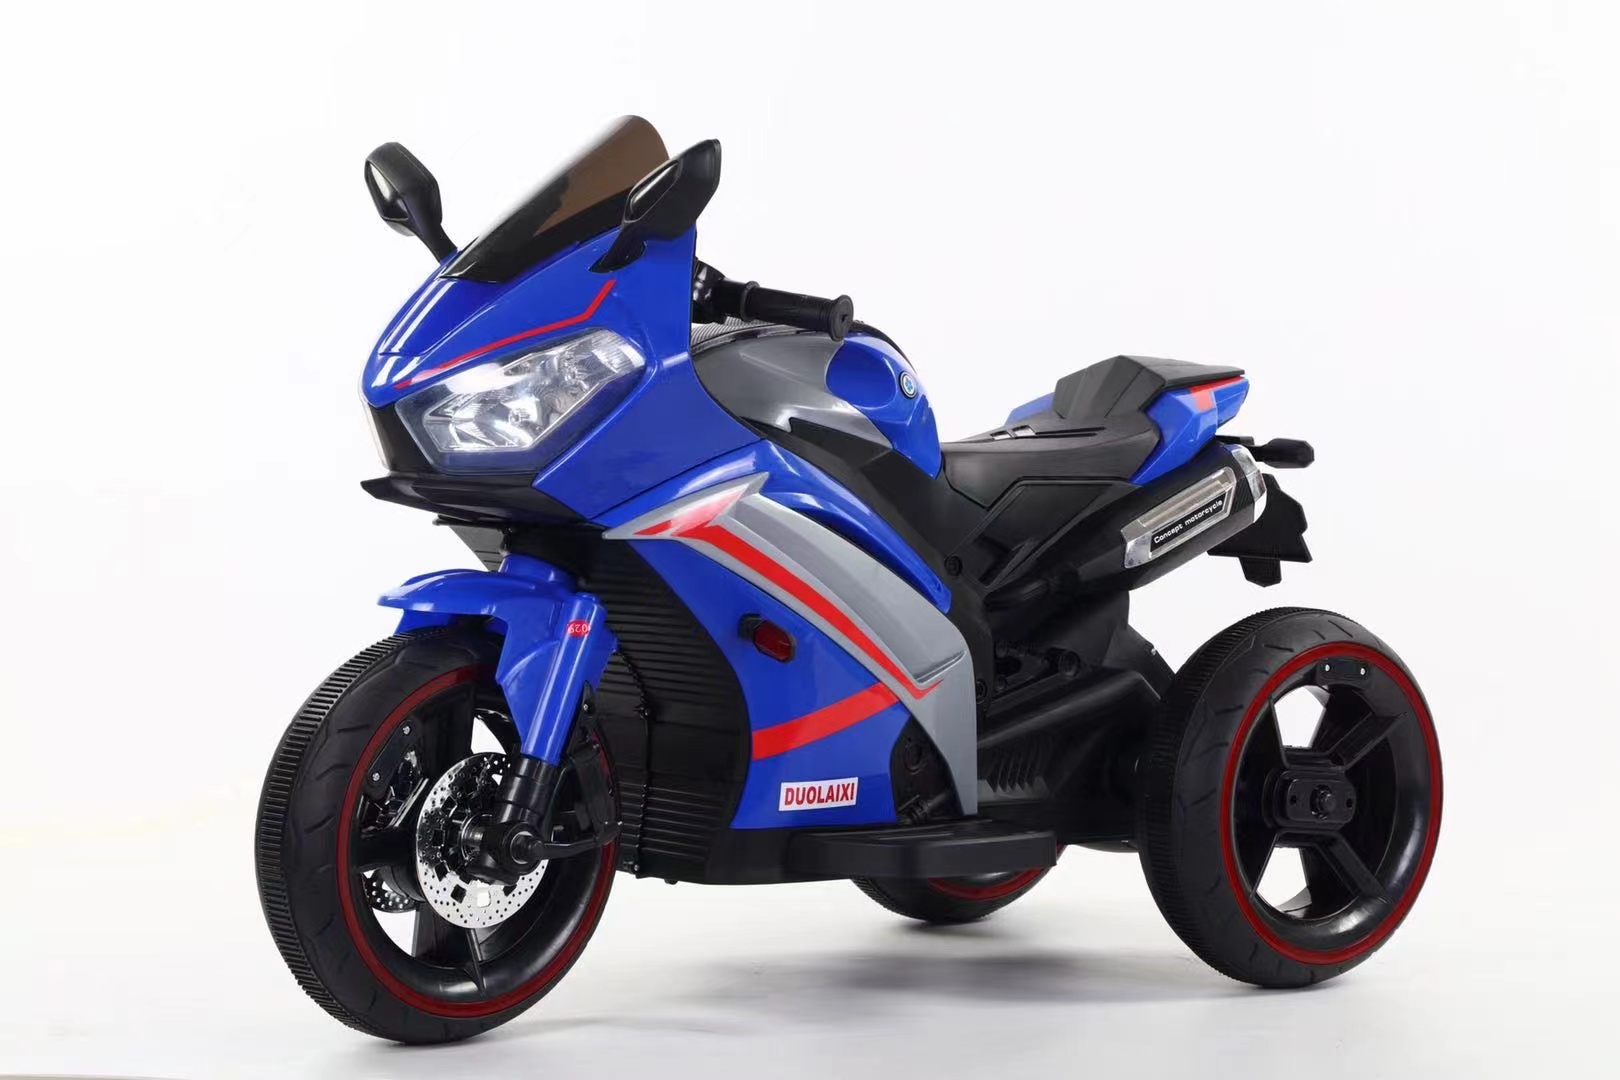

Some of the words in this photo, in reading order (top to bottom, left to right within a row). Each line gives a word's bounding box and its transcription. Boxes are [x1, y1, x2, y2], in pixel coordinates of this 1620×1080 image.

[1153, 522, 1184, 544] Concept
[1184, 499, 1223, 526] motorcycle
[784, 782, 855, 806] DUOLAIXI
